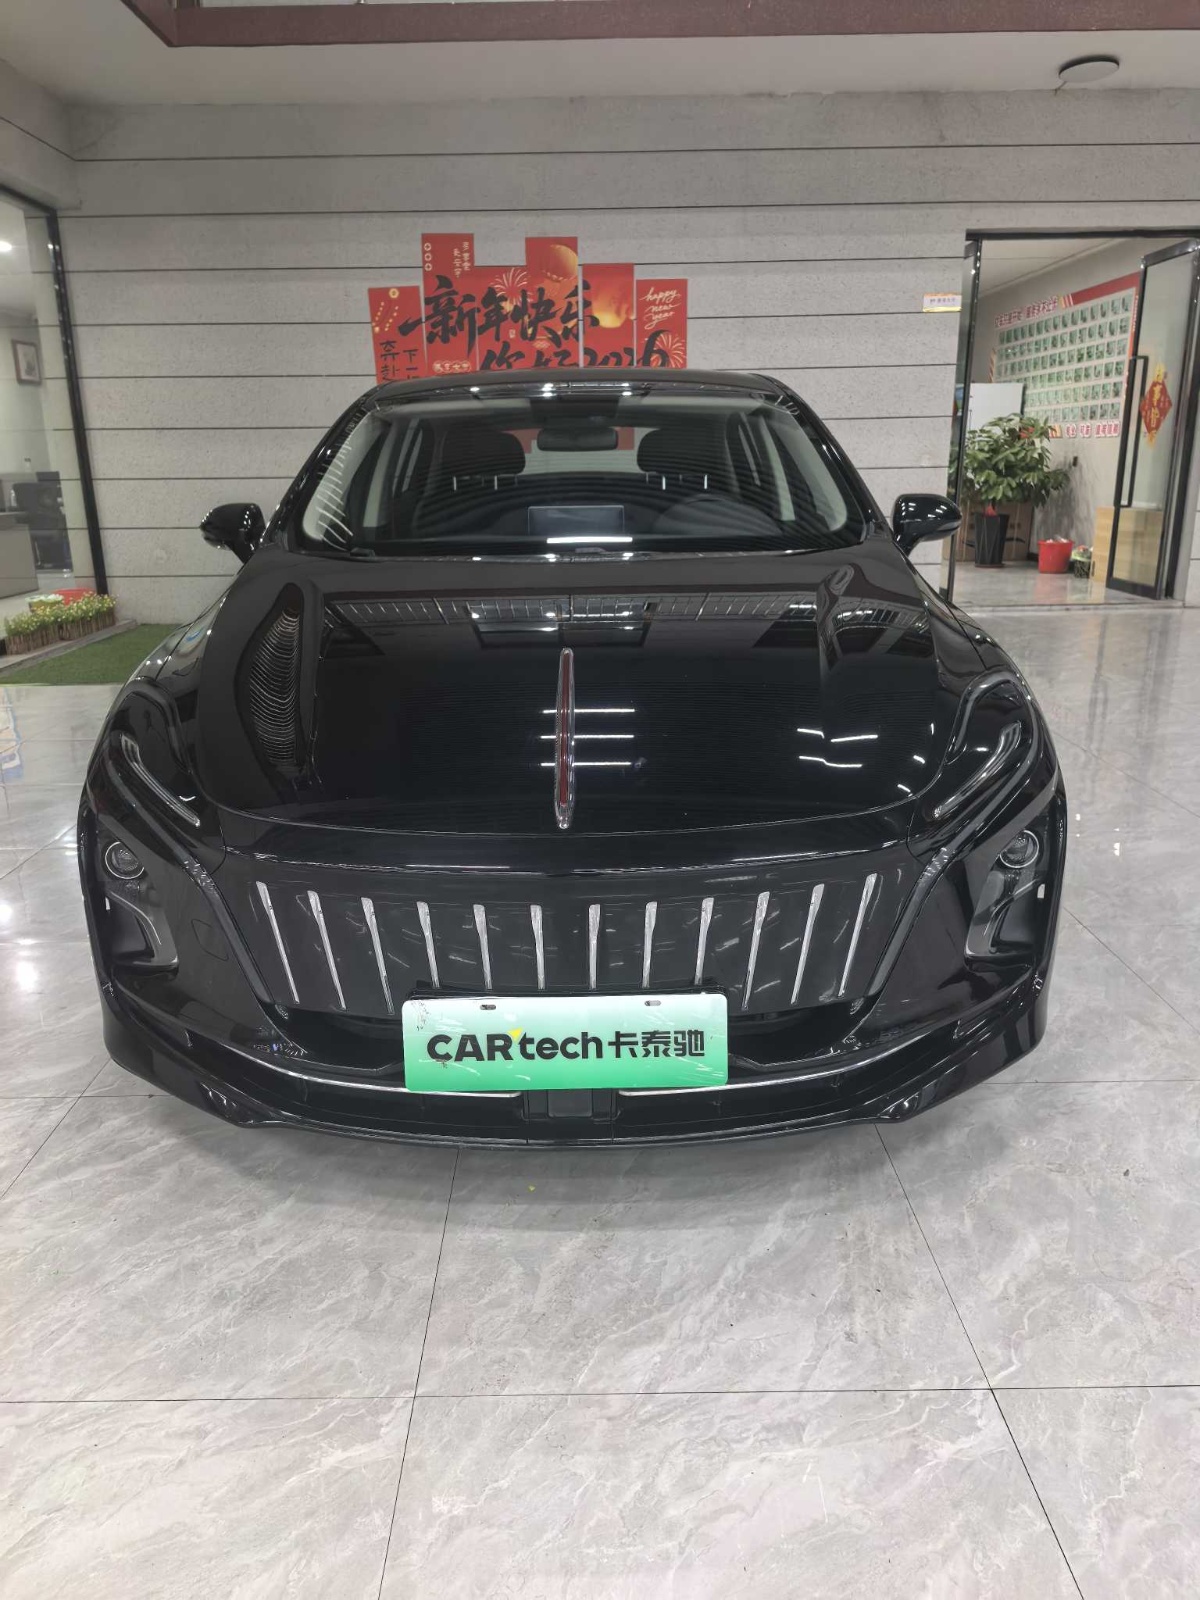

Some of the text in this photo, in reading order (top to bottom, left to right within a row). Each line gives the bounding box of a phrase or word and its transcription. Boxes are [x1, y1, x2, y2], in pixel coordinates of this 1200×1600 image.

[639, 286, 682, 304] happy
[398, 274, 600, 358] 新年快乐
[644, 302, 682, 313] new
[643, 312, 675, 330] year
[403, 349, 419, 379] 下一
[427, 1029, 705, 1062] CARtech 卡泰驰
